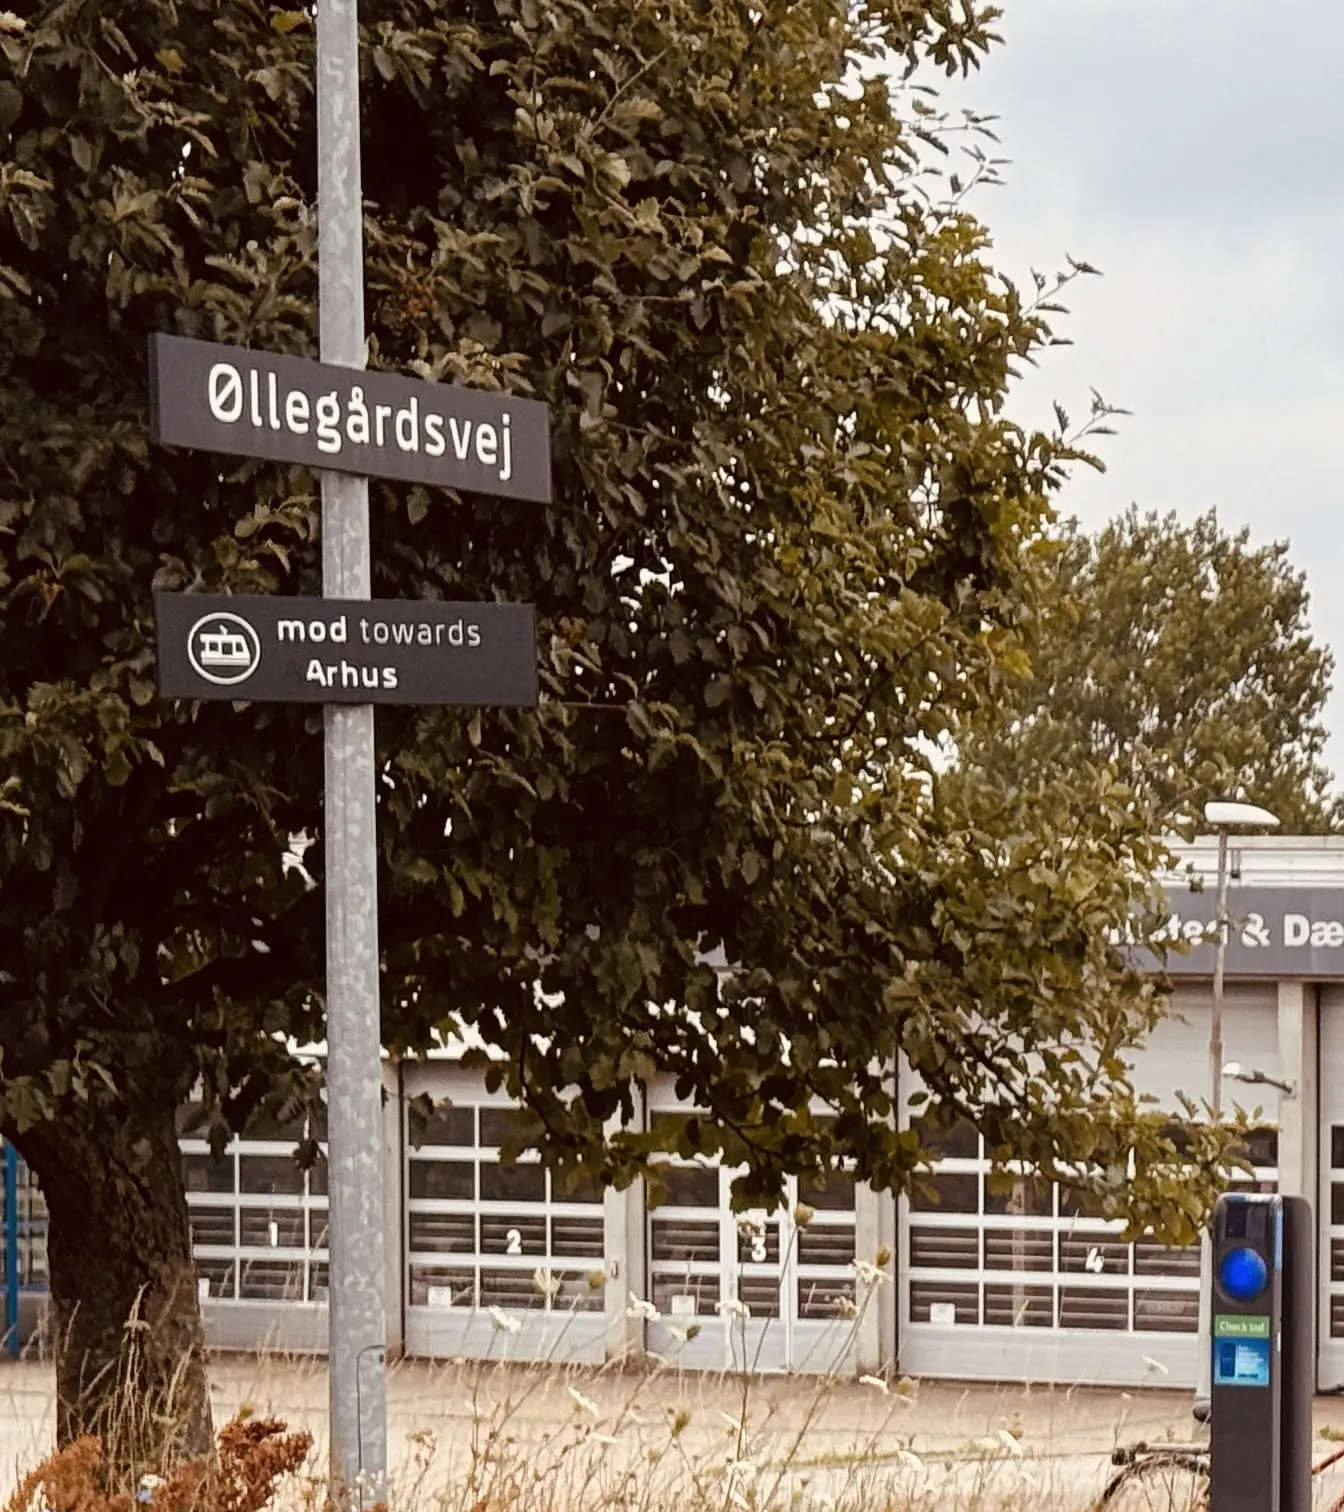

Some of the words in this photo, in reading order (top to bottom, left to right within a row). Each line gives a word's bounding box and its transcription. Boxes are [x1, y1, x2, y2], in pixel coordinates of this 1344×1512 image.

[208, 363, 512, 480] Øllegårdsvej
[277, 616, 346, 642] mod
[360, 618, 481, 647] towards
[306, 660, 398, 688] Arhus
[1241, 913, 1270, 947] &
[507, 1229, 521, 1253] 2
